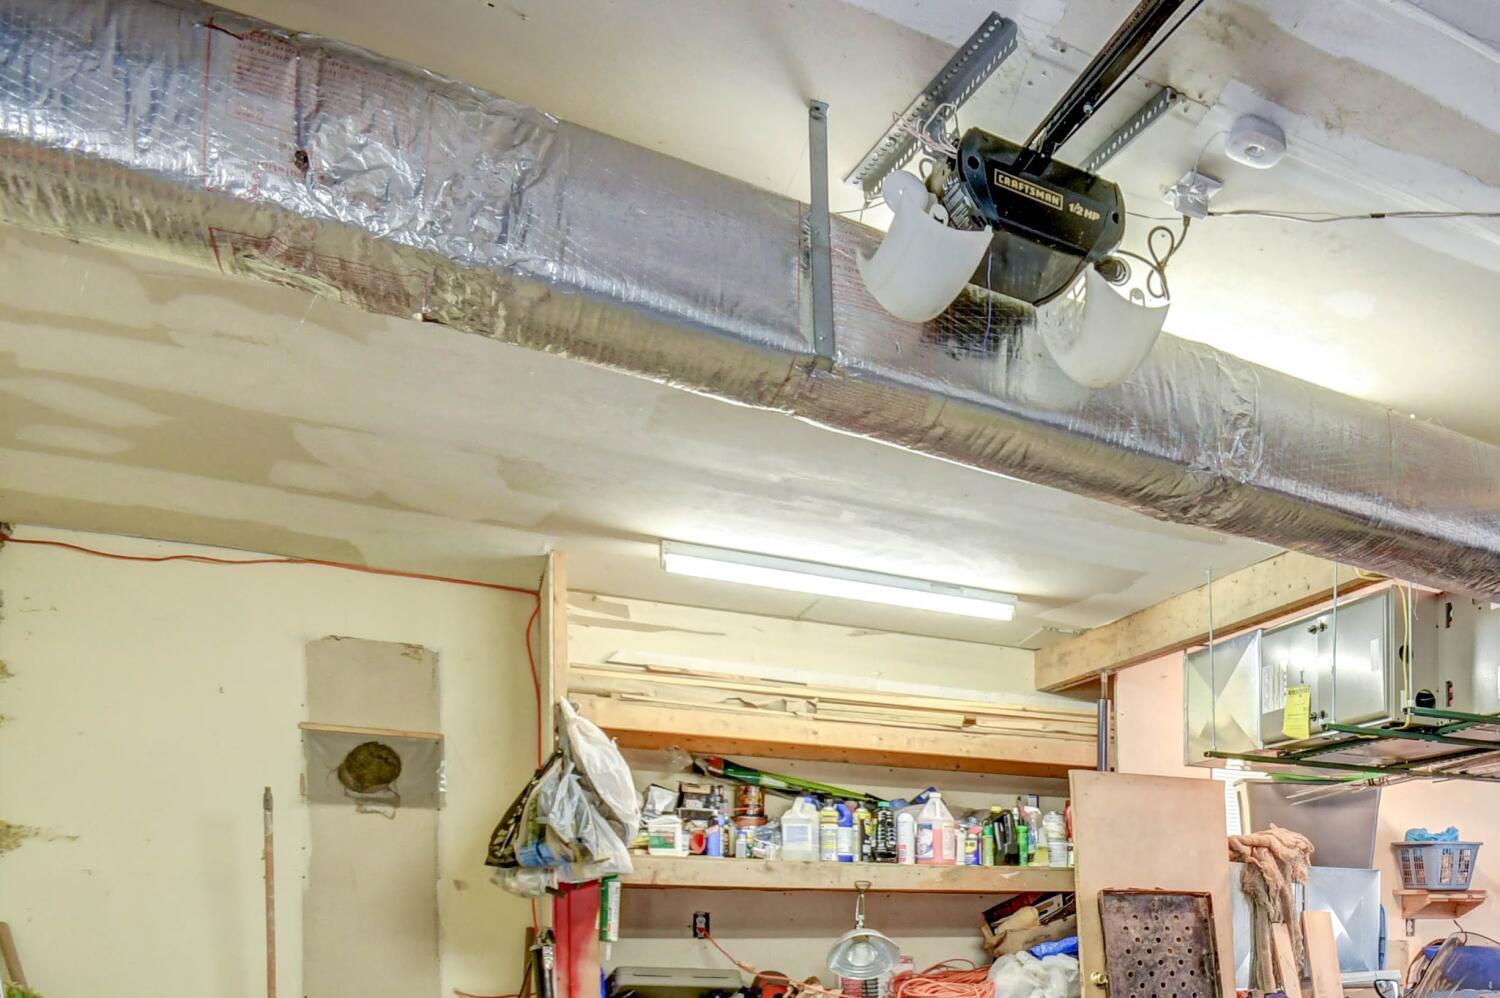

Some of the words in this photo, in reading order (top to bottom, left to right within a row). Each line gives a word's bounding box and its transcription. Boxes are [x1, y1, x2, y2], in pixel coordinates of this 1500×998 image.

[997, 174, 1061, 207] CRAFTSMAN
[1068, 202, 1084, 217] 1/2
[1083, 208, 1101, 221] HP
